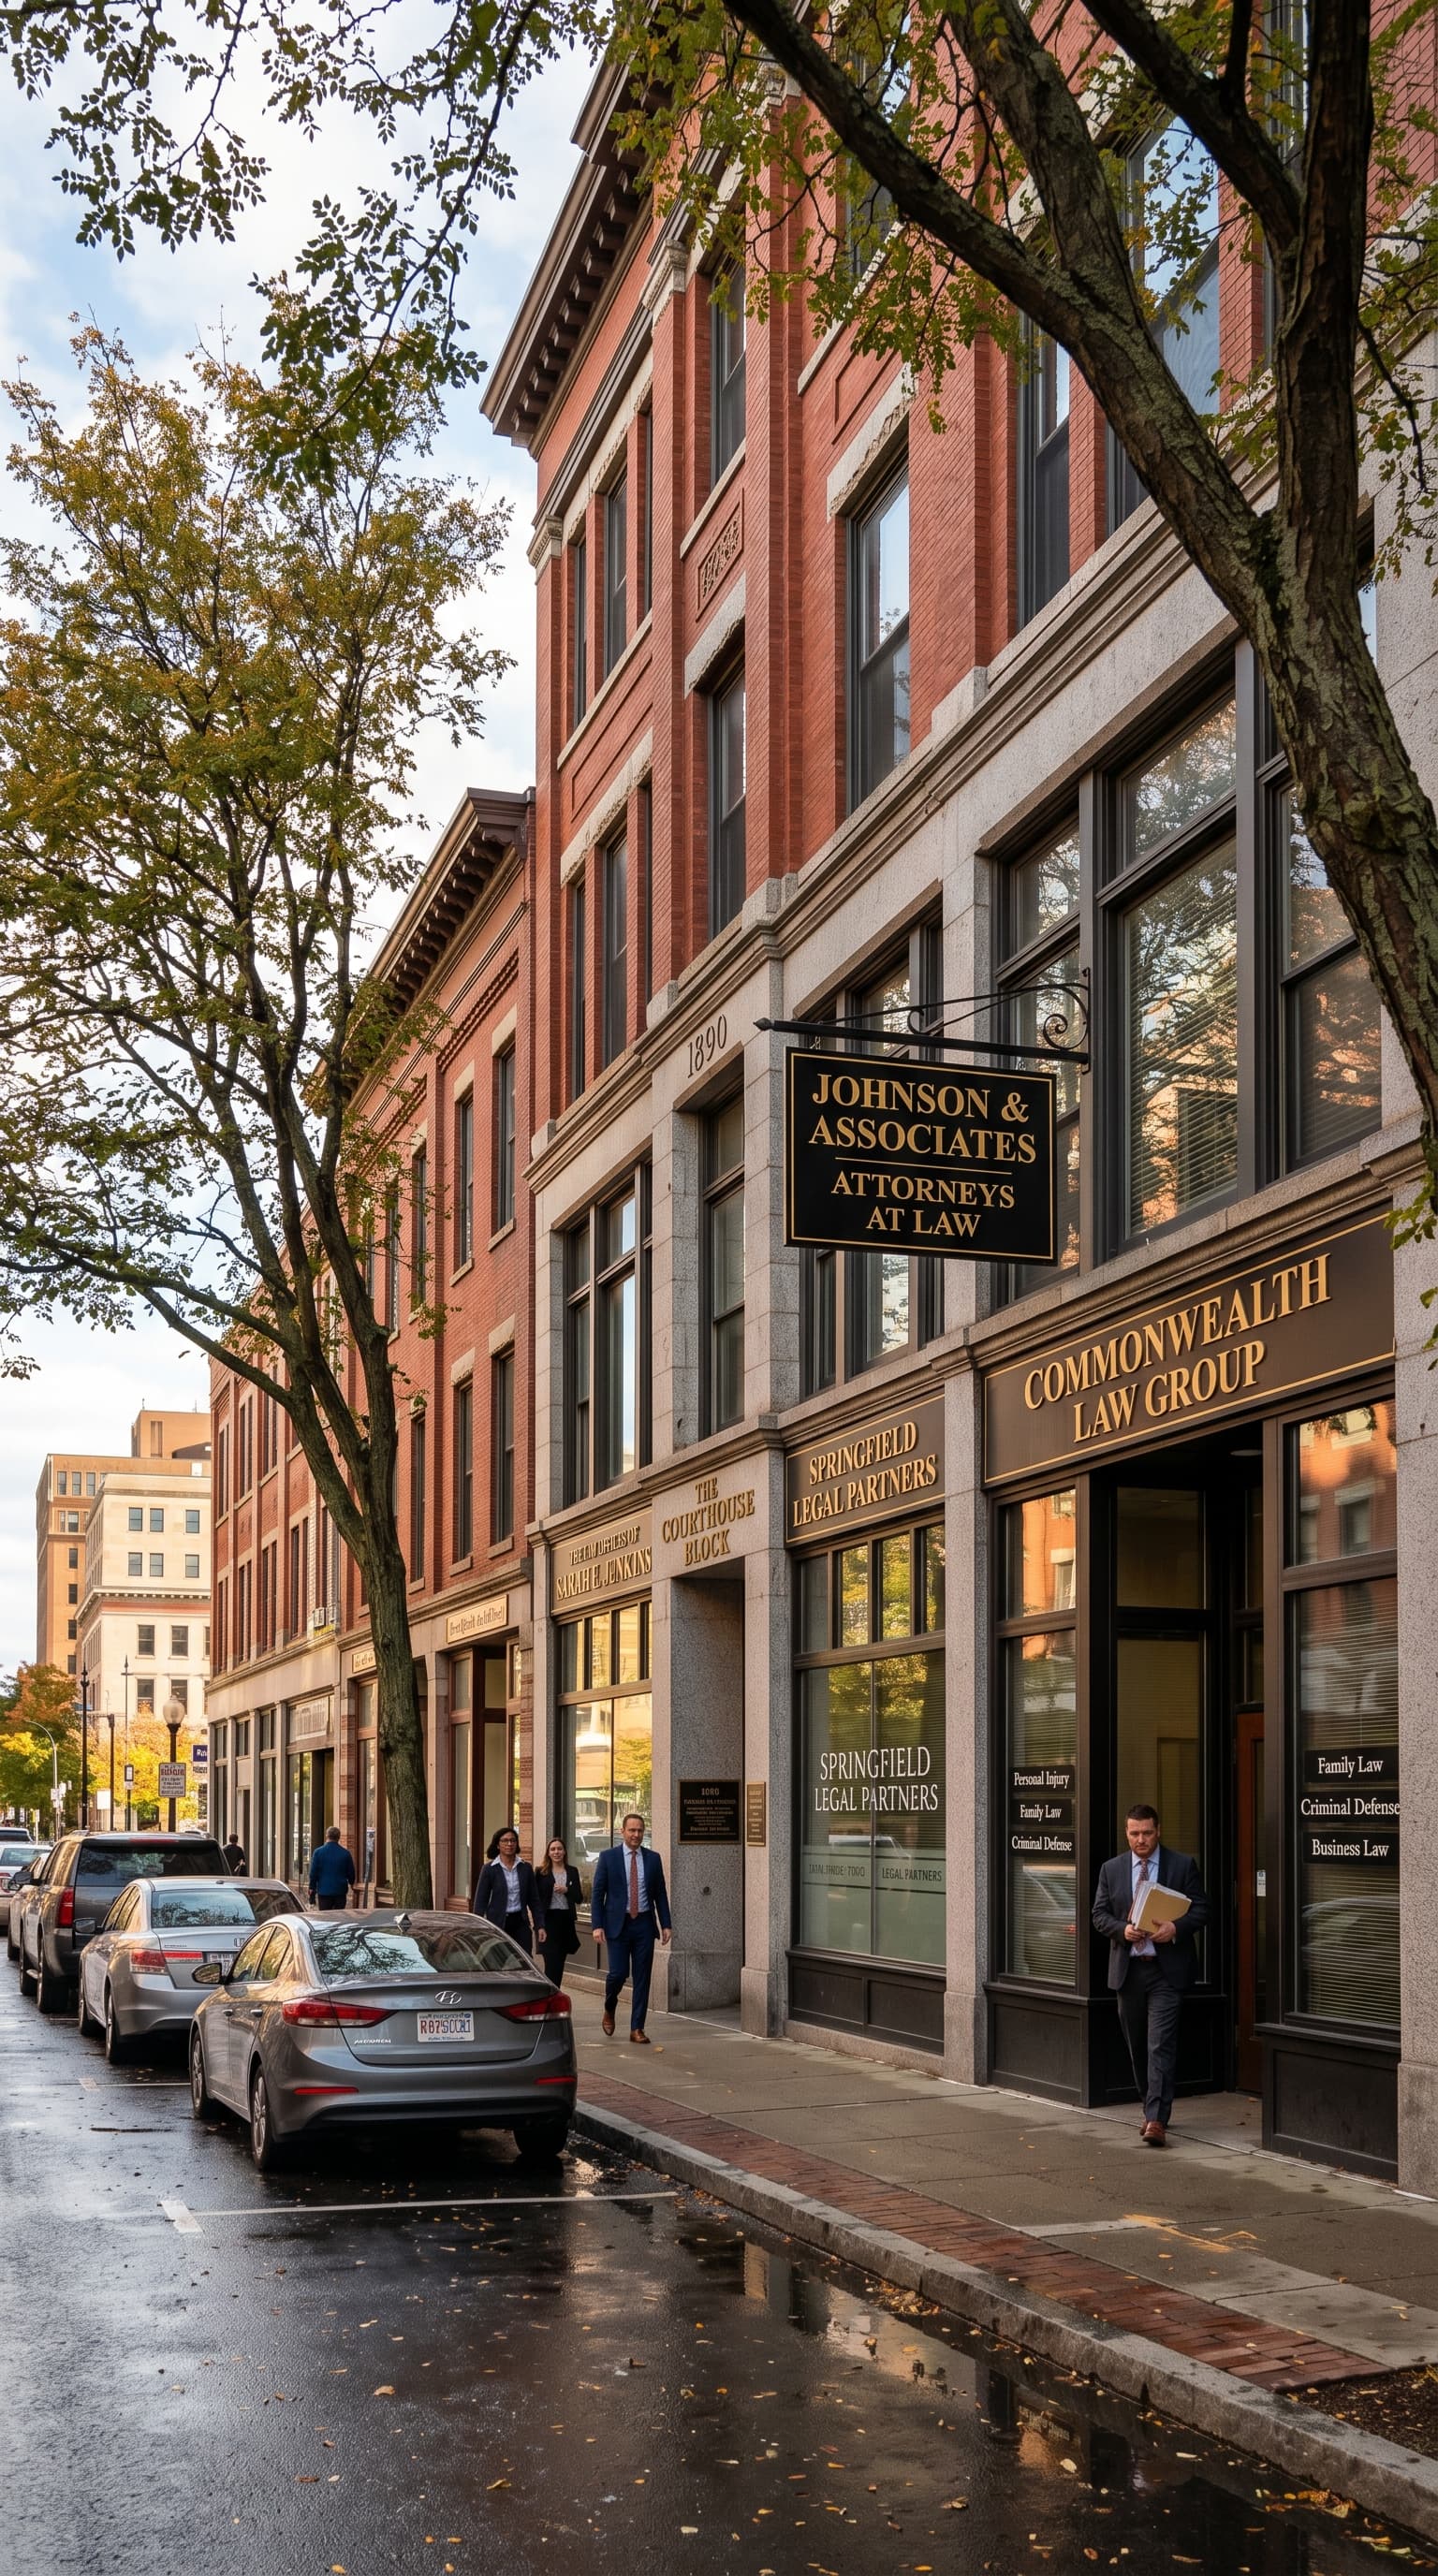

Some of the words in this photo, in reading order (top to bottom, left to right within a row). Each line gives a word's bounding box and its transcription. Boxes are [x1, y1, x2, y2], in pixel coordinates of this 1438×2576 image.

[687, 1014, 727, 1078] 1890
[812, 1074, 990, 1120] JOHNSON
[1001, 1091, 1029, 1122] &
[808, 1115, 1036, 1164] ASSOCIATES
[830, 1170, 1015, 1208] ATTORNEYS
[865, 1206, 905, 1232] AT
[912, 1209, 981, 1237] LAW
[1024, 1252, 1333, 1411] COMMONWEALTH
[1073, 1383, 1137, 1443] LAW
[1144, 1339, 1266, 1417] GROUP
[808, 1421, 918, 1486] SPRINGFIELD
[695, 1476, 719, 1504] THE
[793, 1486, 844, 1528] LEGAL
[846, 1453, 938, 1512] PARTNERS
[662, 1488, 756, 1544] COURTHOUSE
[684, 1529, 731, 1567] BLOCK
[820, 1746, 931, 1781] SPRINGFIELD
[1013, 1770, 1045, 1786] Personal
[1046, 1770, 1070, 1789] Injury
[1317, 1755, 1357, 1778] Family
[1357, 1756, 1384, 1773] Law
[814, 1787, 858, 1811] LEGAL
[861, 1784, 939, 1811] PARTNERS
[1020, 1804, 1044, 1822] Family
[1045, 1804, 1063, 1819] Law
[1300, 1798, 1351, 1816] Criminal
[1354, 1797, 1401, 1815] Defense
[1011, 1836, 1043, 1850] Criminal
[1044, 1836, 1073, 1852] Defense
[1312, 1838, 1361, 1856] Business
[1363, 1839, 1390, 1857] Law
[882, 1867, 903, 1880] LEGAL
[904, 1868, 942, 1881] PARTNERS
